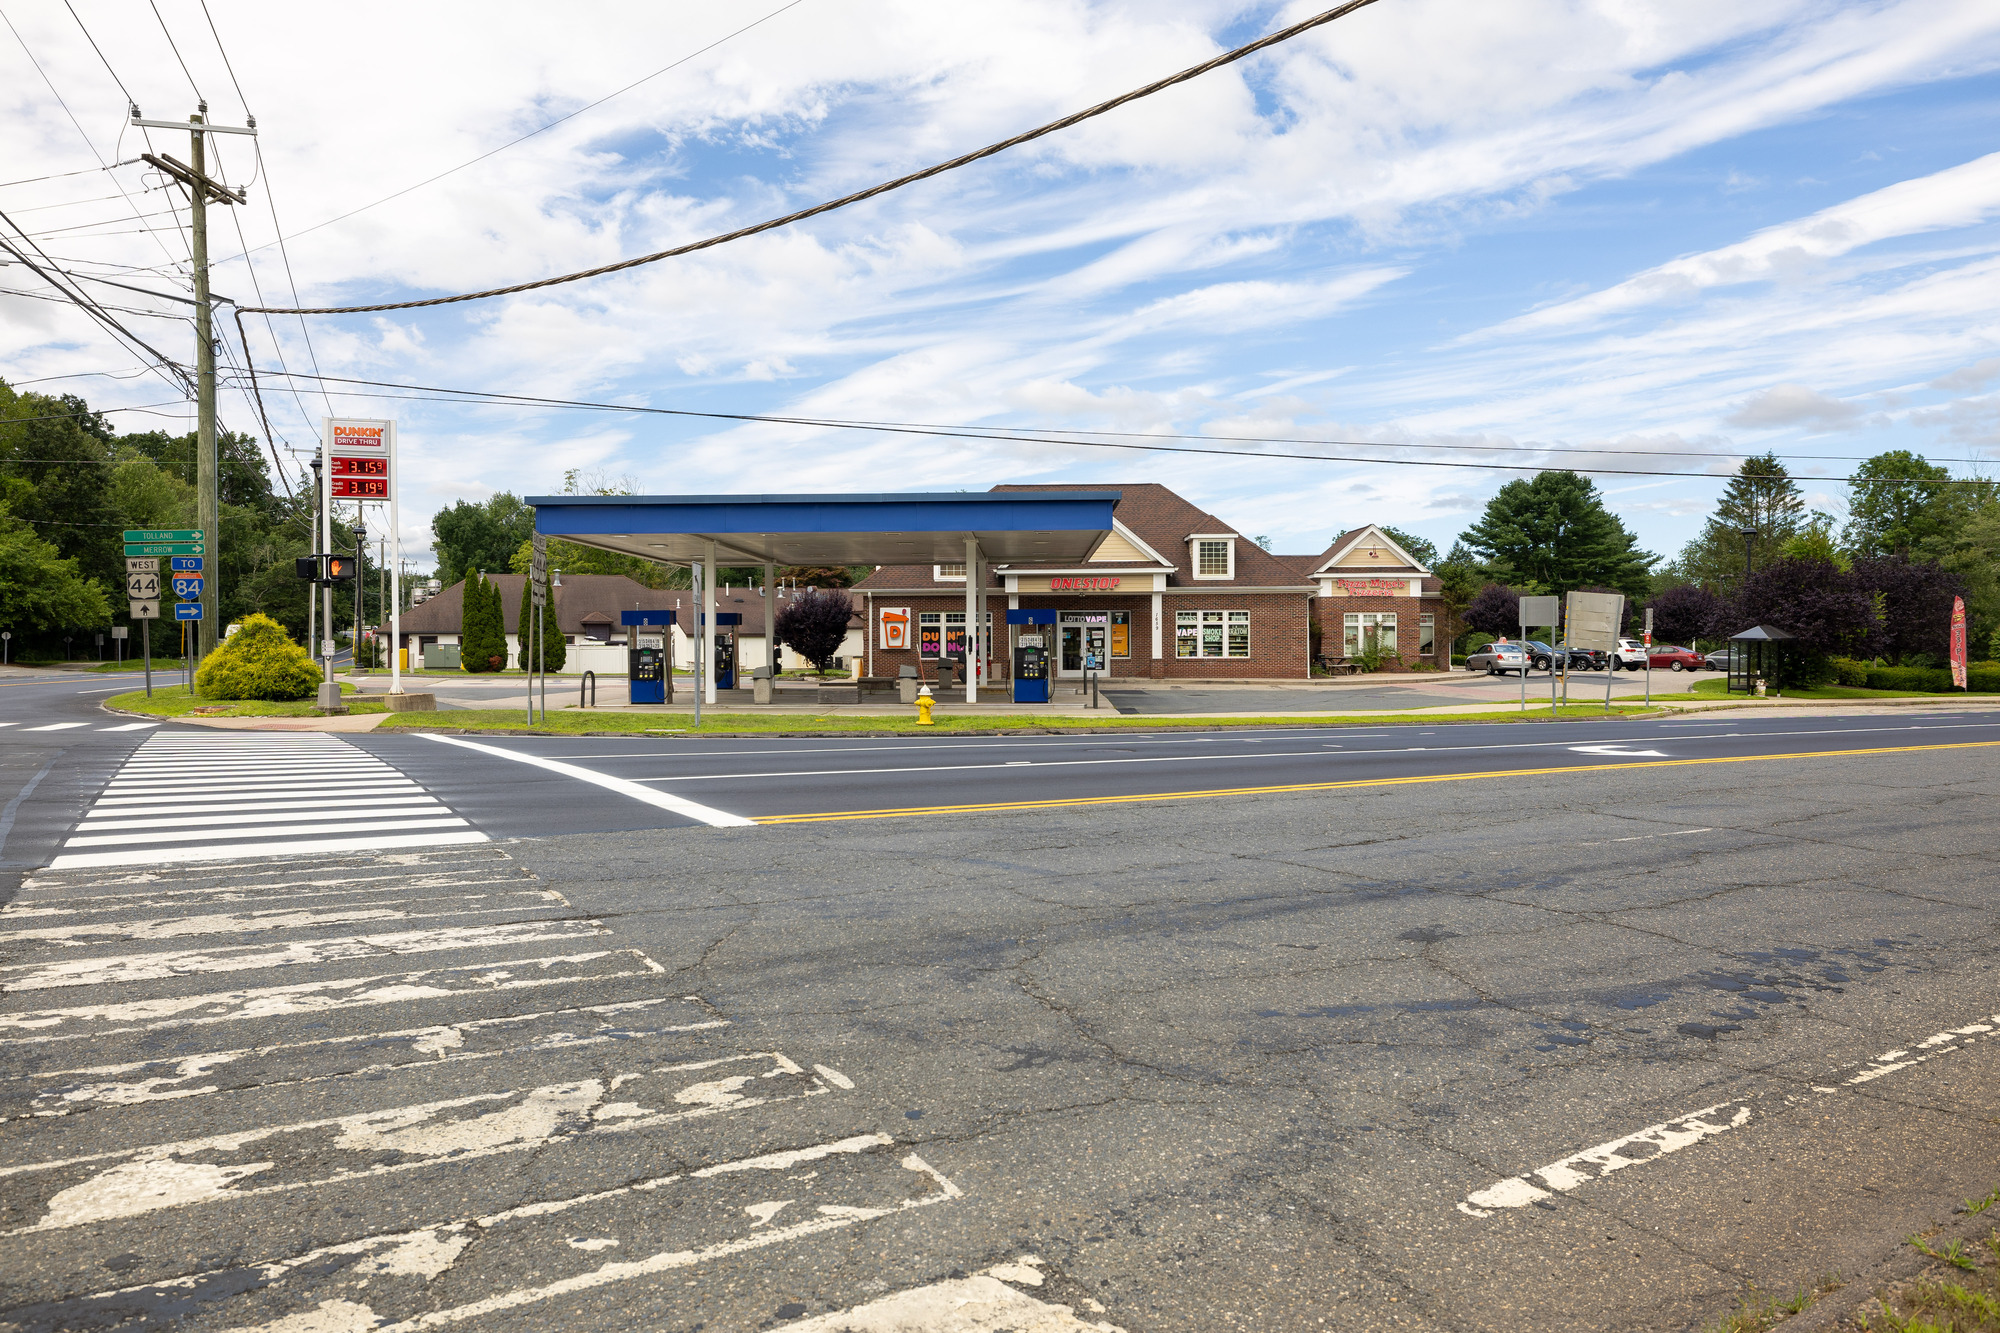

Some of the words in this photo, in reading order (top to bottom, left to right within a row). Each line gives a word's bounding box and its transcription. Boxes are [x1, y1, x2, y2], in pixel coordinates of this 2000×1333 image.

[130, 561, 154, 569] WEST
[131, 579, 156, 592] 44
[176, 580, 200, 595] 84
[1050, 577, 1121, 589] ONESTOP
[1336, 578, 1367, 588] Pizza
[1370, 578, 1405, 589] Mike's
[1348, 588, 1394, 596] Pizzeria
[890, 625, 901, 638] D
[1177, 628, 1198, 637] VAPE
